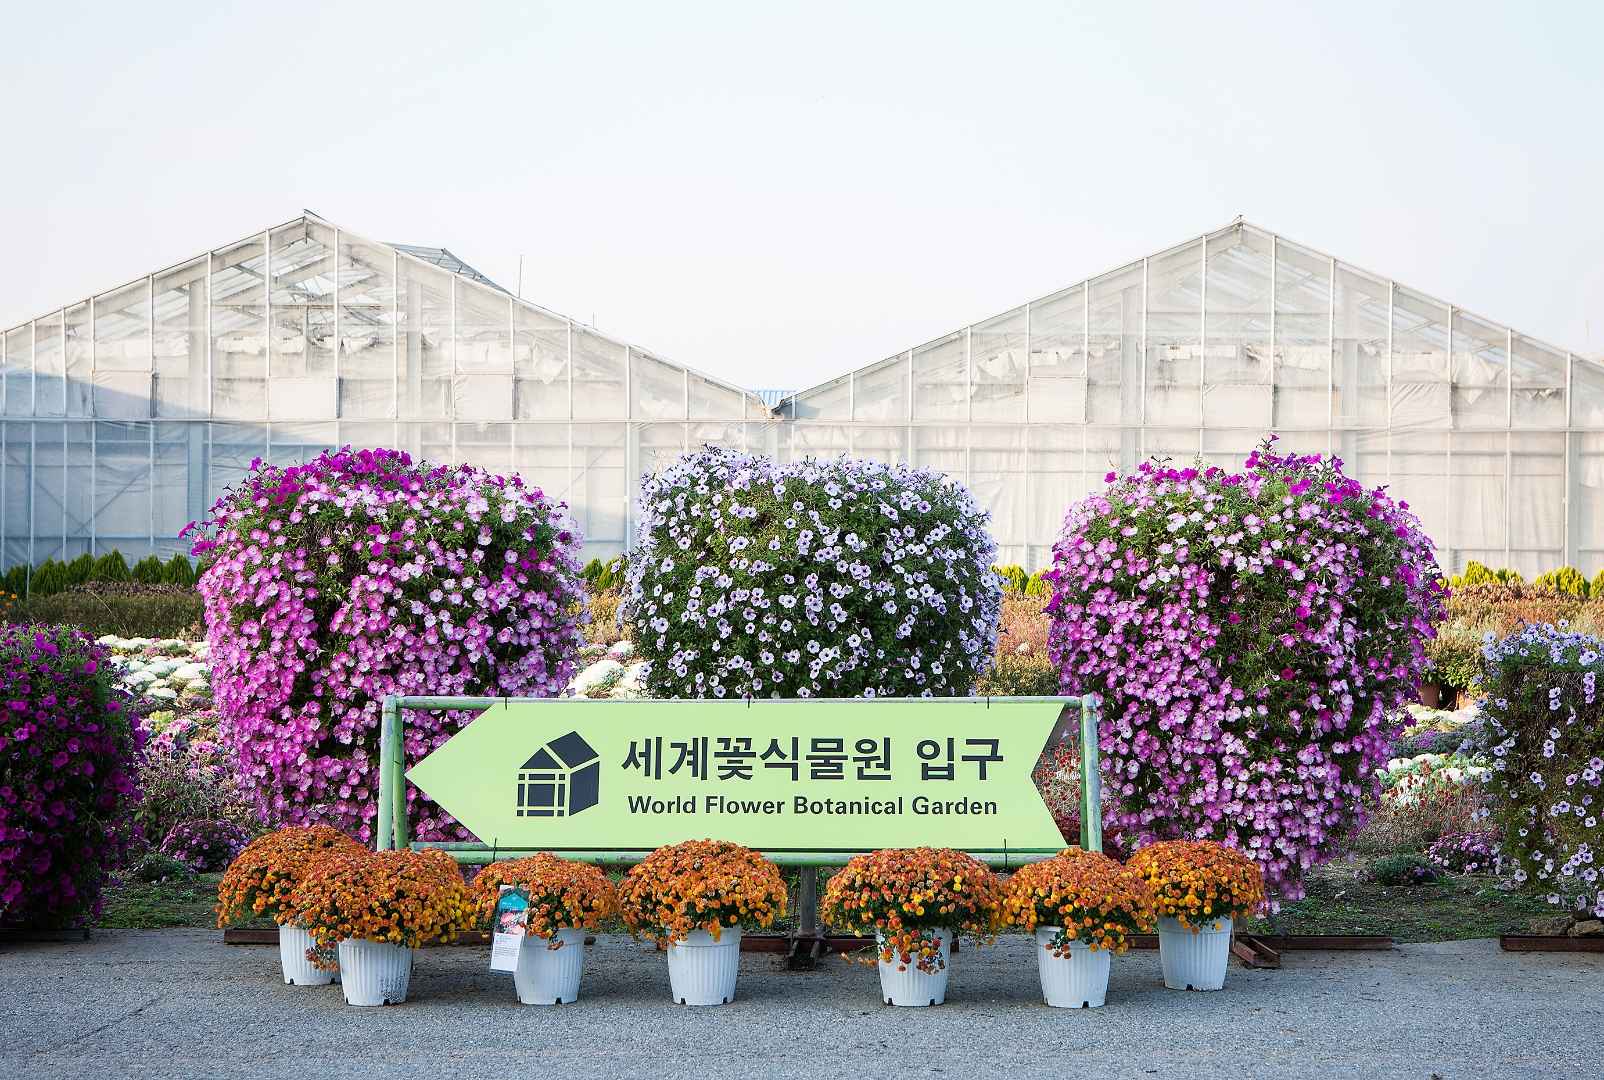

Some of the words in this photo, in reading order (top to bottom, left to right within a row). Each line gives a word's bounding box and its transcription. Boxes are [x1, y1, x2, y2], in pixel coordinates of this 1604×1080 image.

[621, 736, 892, 782] 세계꽃식물원
[916, 736, 1004, 781] 입구
[627, 795, 696, 814] World
[705, 795, 786, 814] Flower
[793, 795, 903, 815] Botanical
[911, 795, 997, 815] Garden
